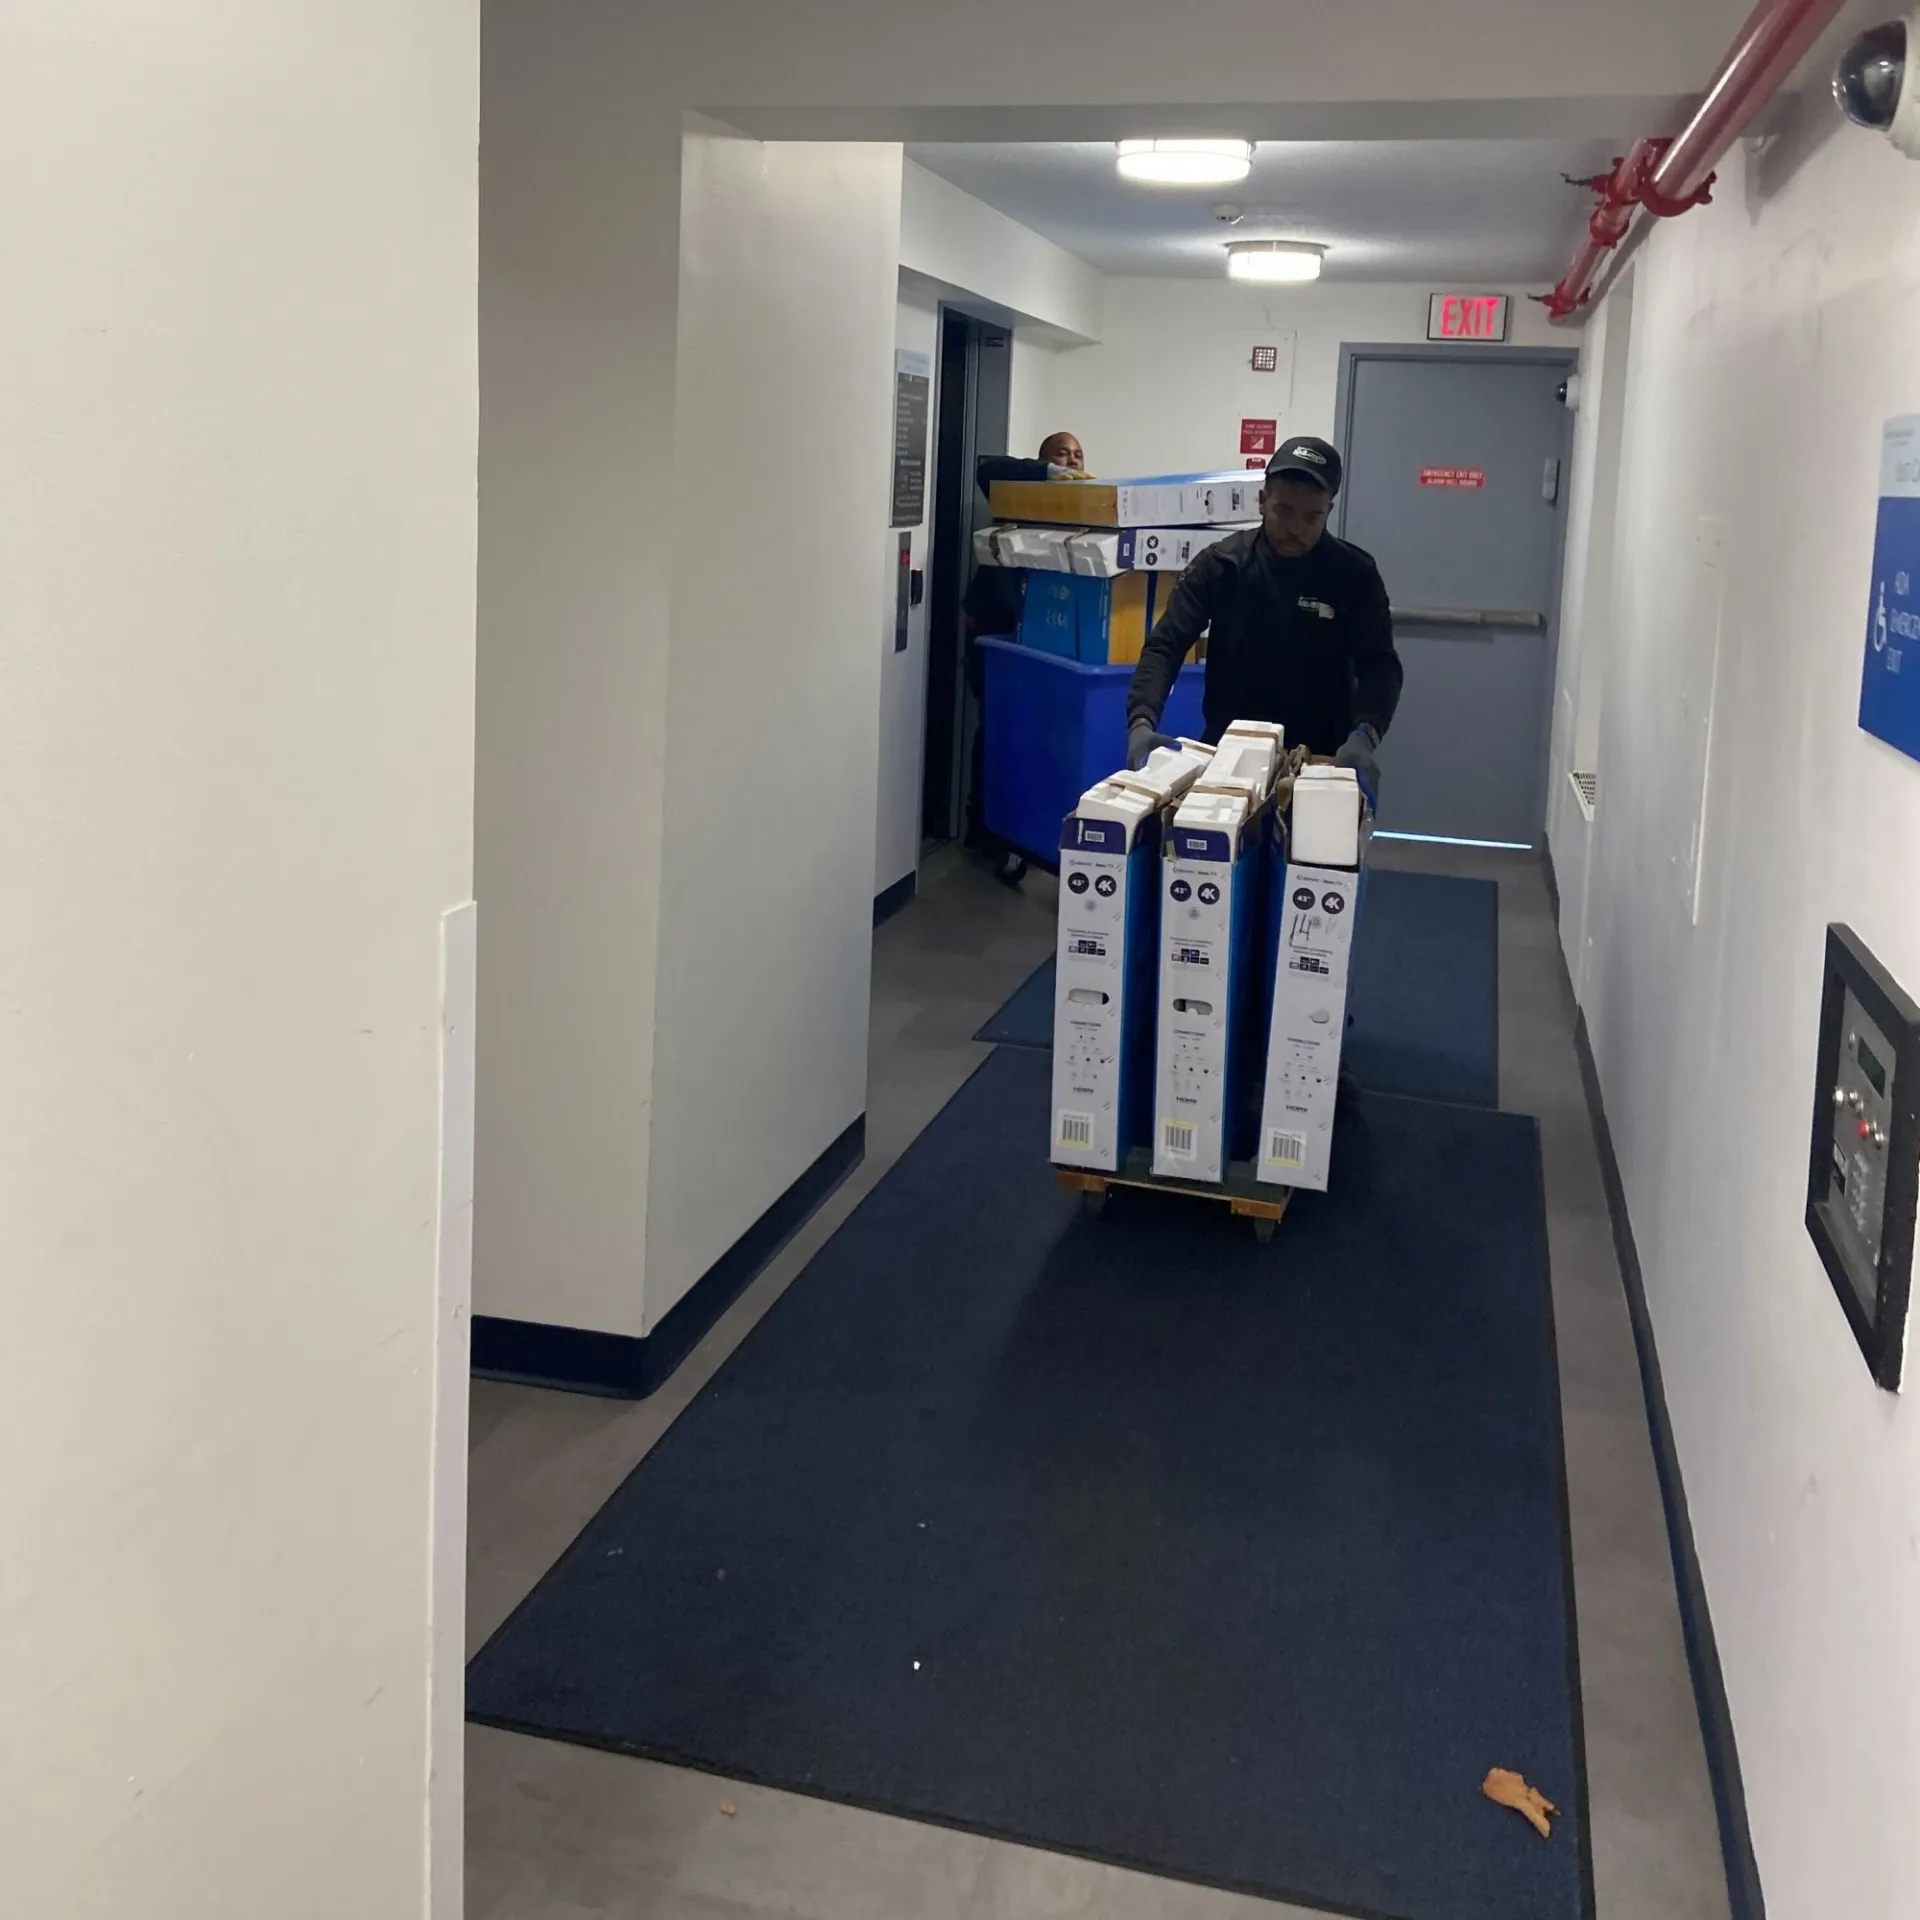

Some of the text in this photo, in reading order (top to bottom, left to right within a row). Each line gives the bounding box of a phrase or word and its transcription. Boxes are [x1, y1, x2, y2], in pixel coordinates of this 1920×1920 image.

[1441, 296, 1500, 337] EXIT
[1098, 880, 1113, 892] 4K
[1201, 887, 1216, 900] 4K
[1325, 896, 1341, 911] 4K
